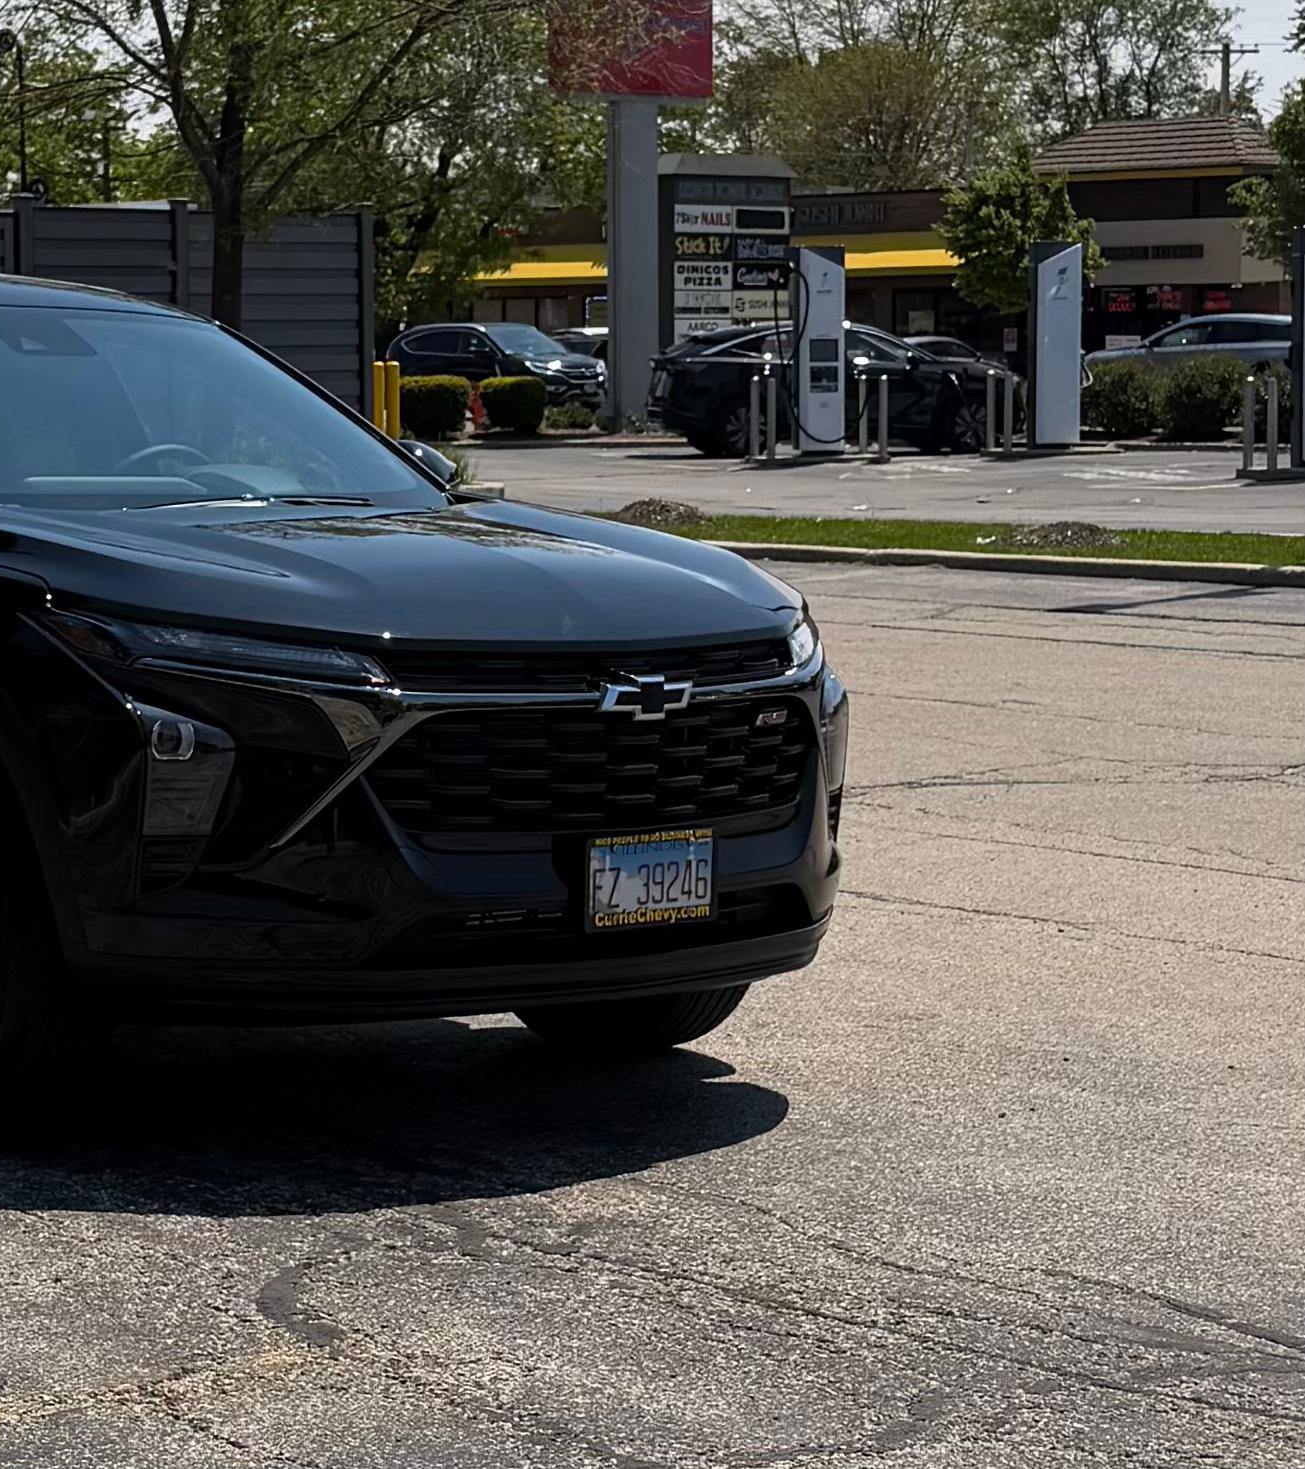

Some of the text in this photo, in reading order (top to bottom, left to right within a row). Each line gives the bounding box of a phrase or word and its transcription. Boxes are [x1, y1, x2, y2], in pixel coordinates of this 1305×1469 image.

[700, 211, 731, 226] NAILS
[675, 236, 706, 255] Stick
[677, 264, 729, 275] DINICOS
[683, 276, 722, 287] PIZZA
[592, 858, 708, 911] FZ 39246
[595, 905, 710, 928] CurrieChevy.com
